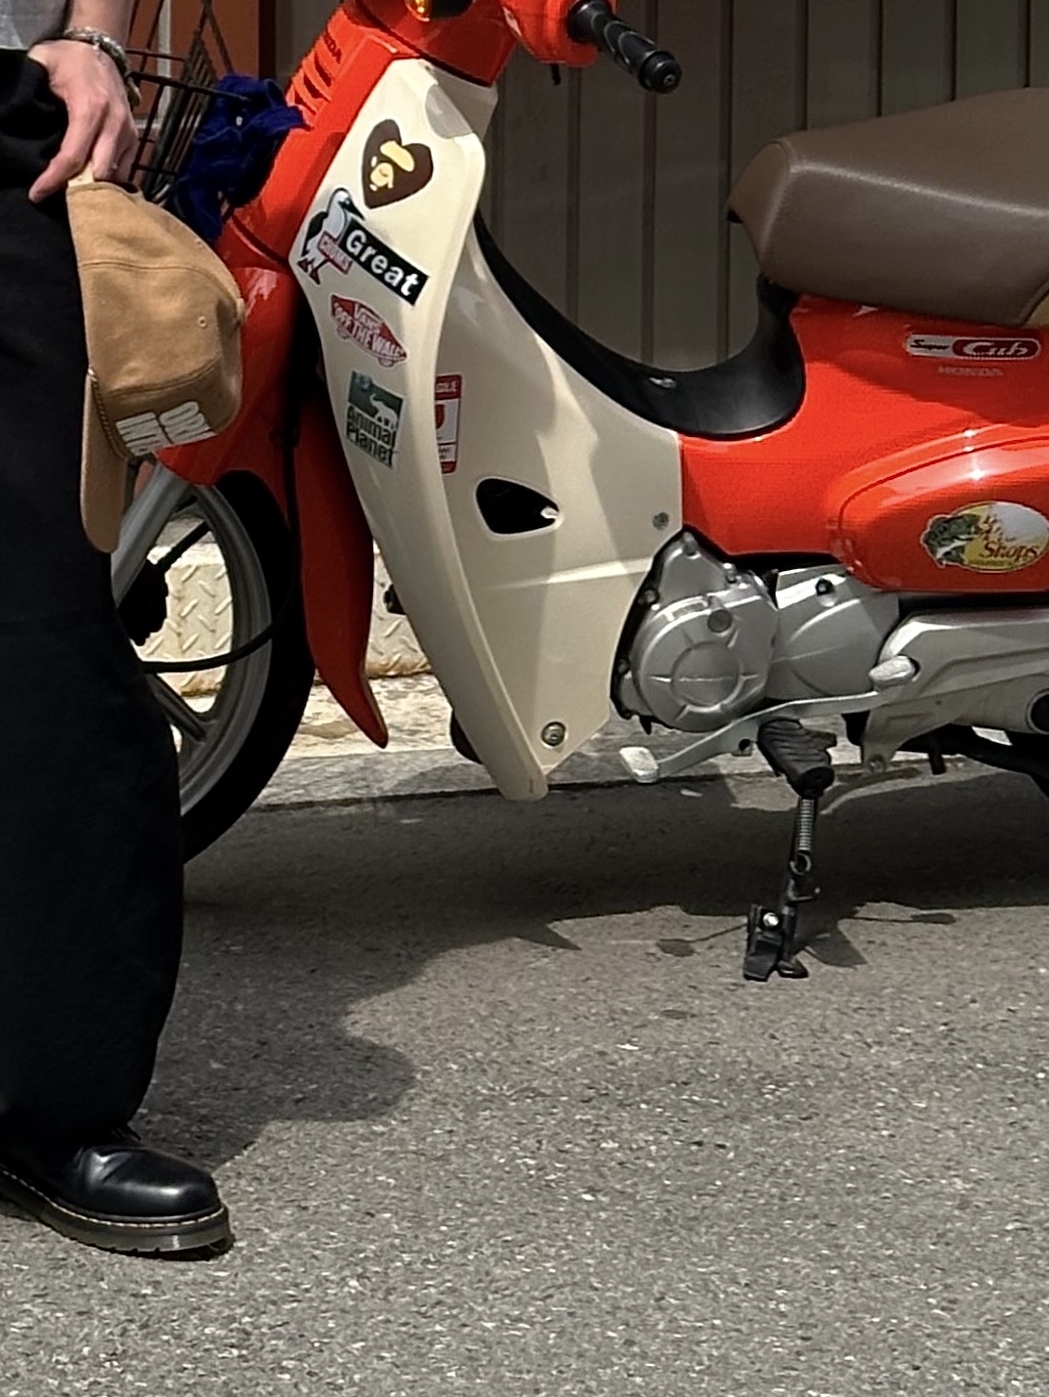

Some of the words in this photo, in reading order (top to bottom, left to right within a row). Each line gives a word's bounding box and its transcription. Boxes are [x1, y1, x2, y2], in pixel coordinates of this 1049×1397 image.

[345, 228, 420, 298] Great
[351, 321, 374, 349] THE
[961, 339, 1030, 357] Cub
[978, 540, 1040, 563] Shops
